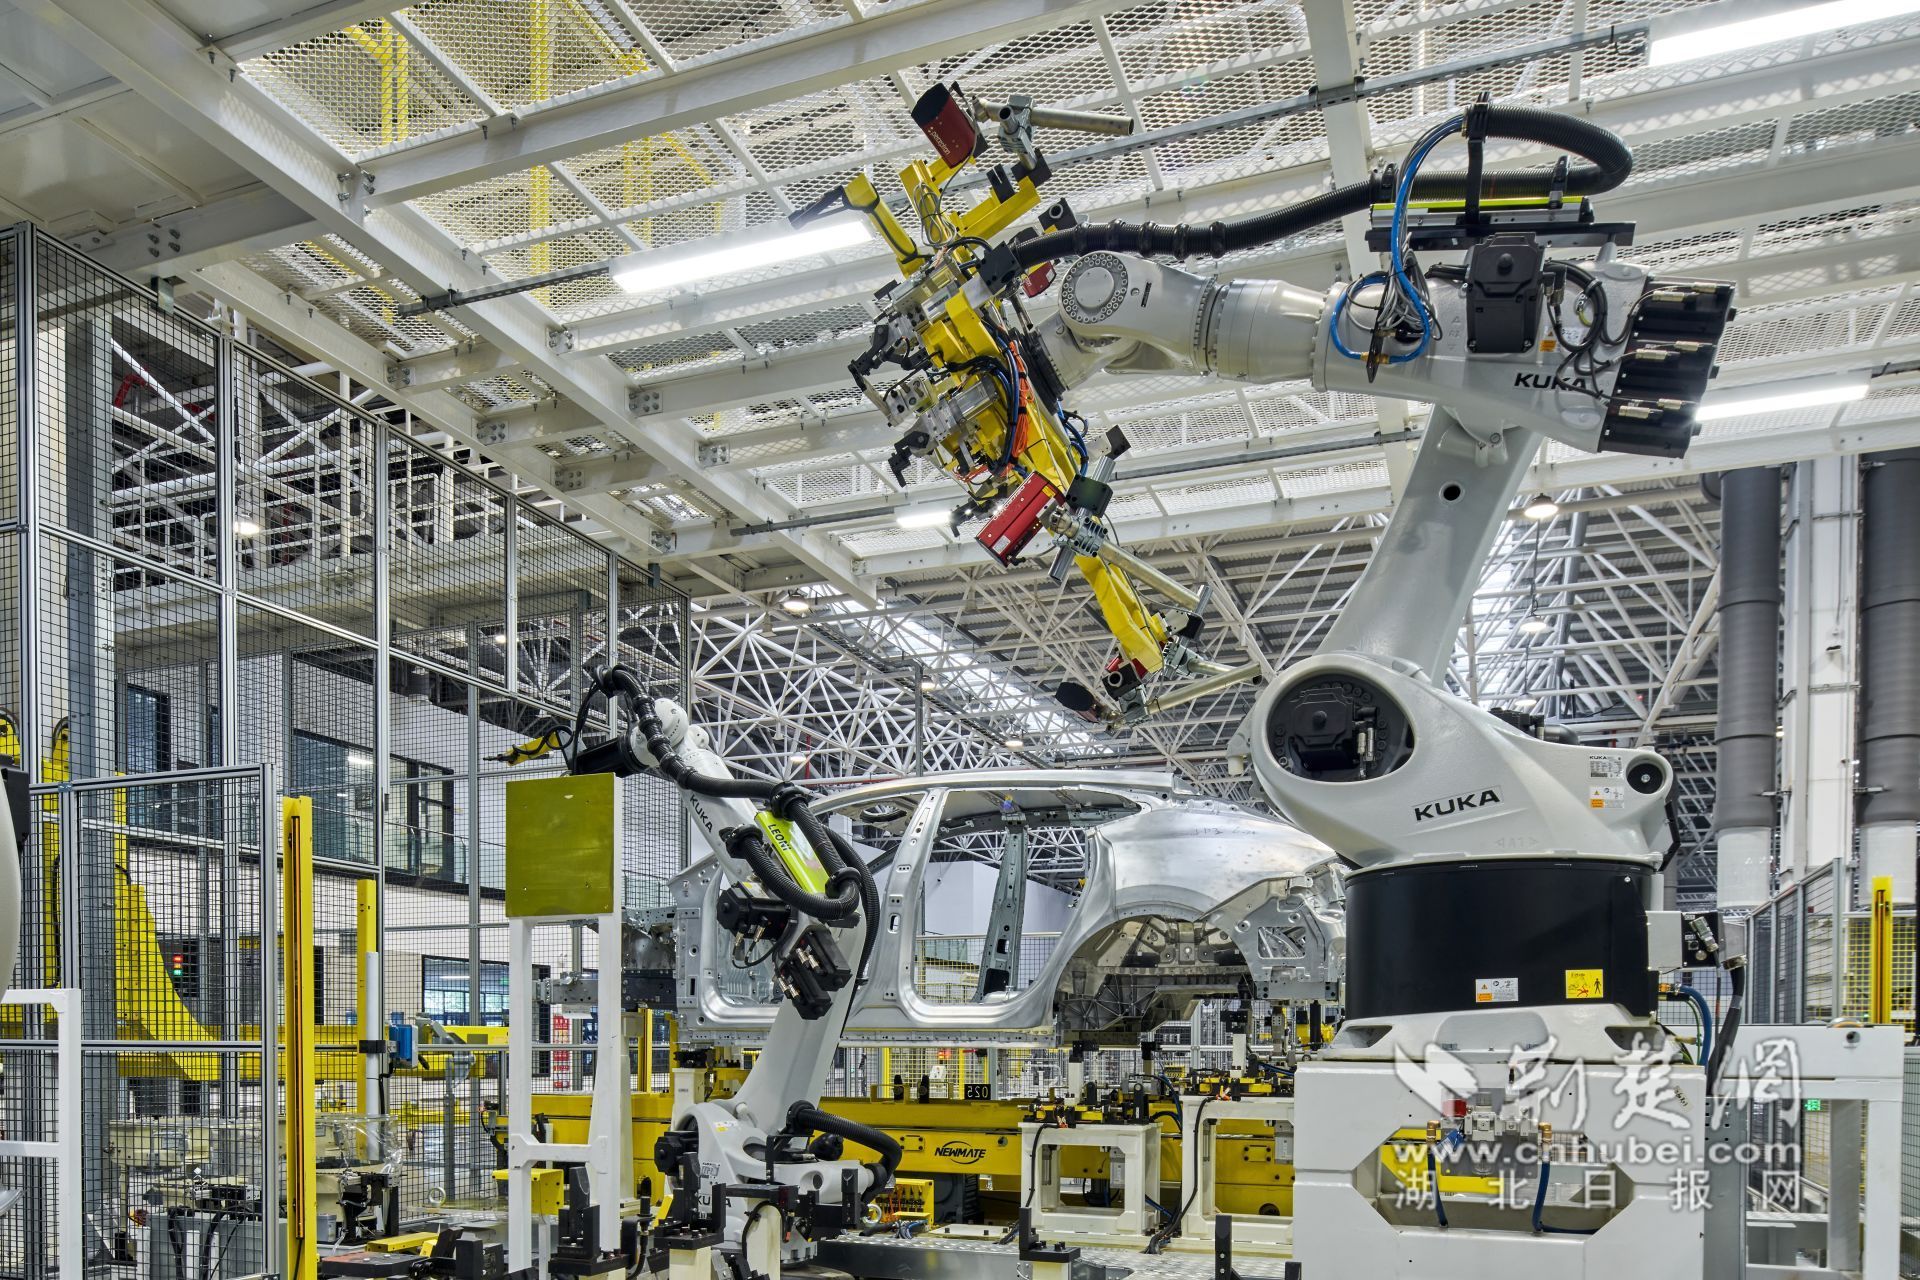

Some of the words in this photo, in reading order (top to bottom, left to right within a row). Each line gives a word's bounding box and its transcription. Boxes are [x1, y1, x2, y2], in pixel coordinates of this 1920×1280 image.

[1514, 372, 1587, 392] KUKA
[690, 794, 713, 833] KUKA
[1414, 789, 1501, 821] KUKA
[935, 1147, 986, 1158] NEWMATE
[698, 1195, 732, 1208] KUA
